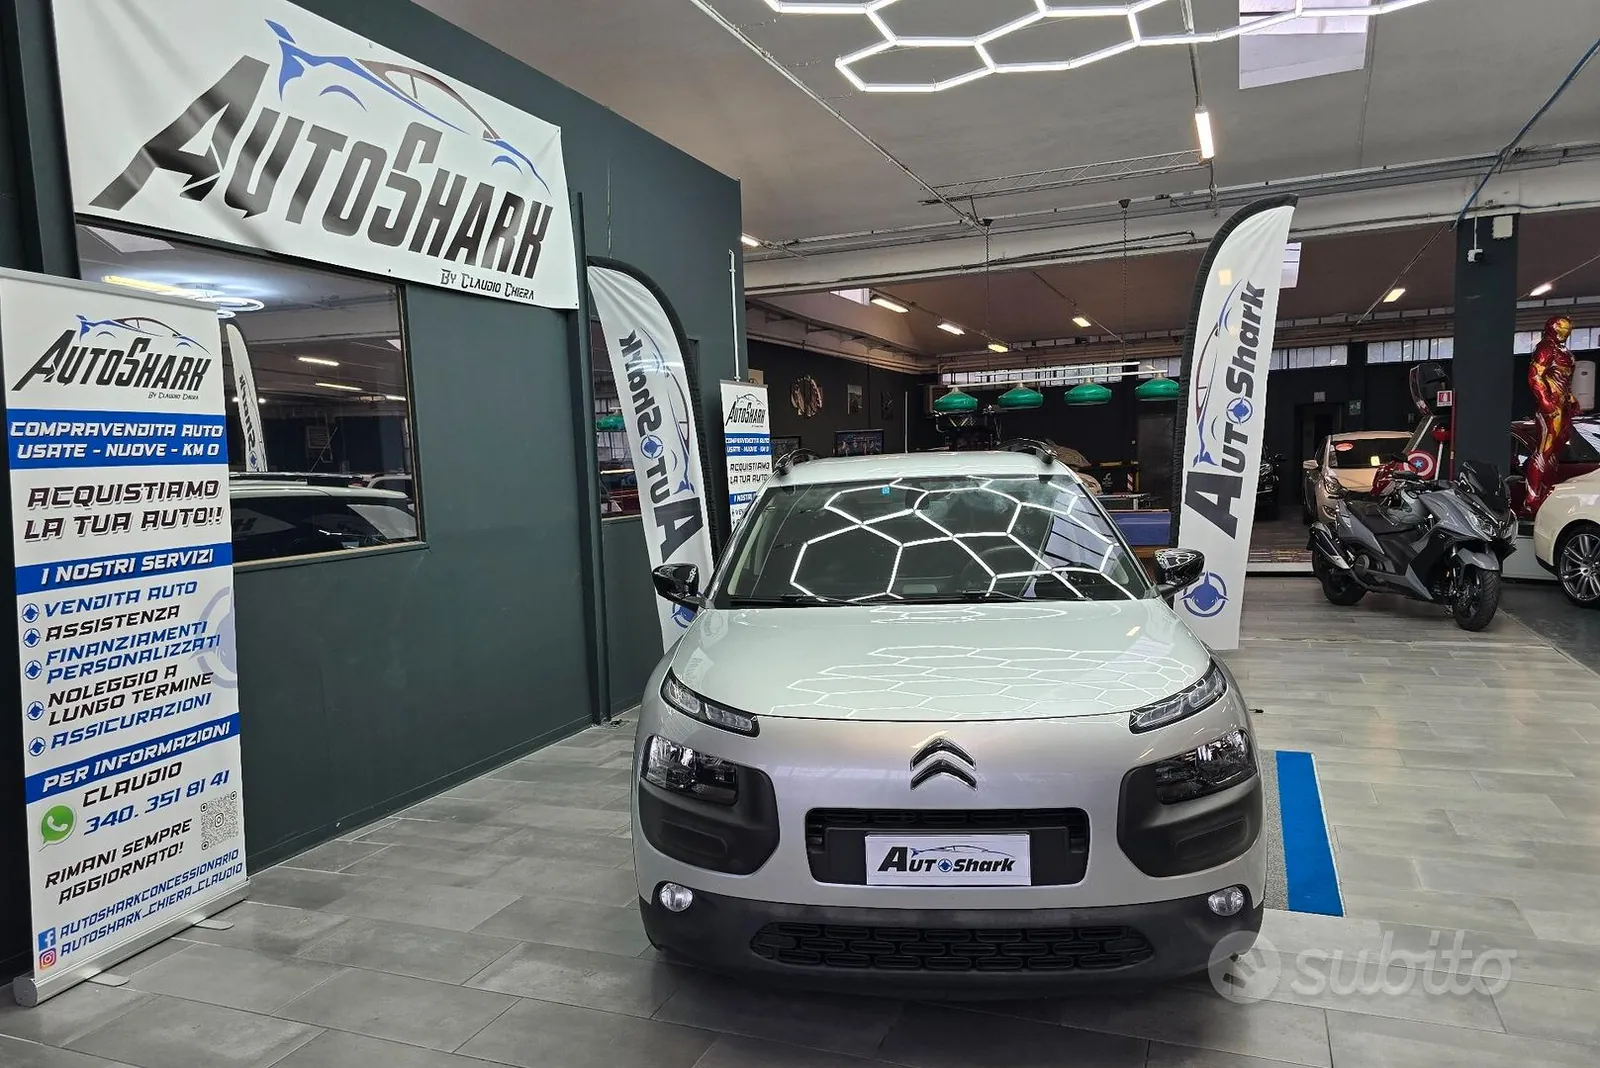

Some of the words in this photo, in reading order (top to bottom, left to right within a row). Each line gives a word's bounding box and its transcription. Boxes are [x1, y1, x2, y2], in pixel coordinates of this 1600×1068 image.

[10, 421, 176, 438] COMPRAVENDITA
[181, 424, 224, 438] AUTO
[17, 443, 88, 459] USATE
[105, 443, 166, 458] NUOVE
[182, 443, 204, 456] KM
[27, 479, 220, 509] ACQUISTIAMO
[24, 517, 65, 541] LA
[73, 511, 132, 537] TUA
[141, 506, 223, 530] AUTO!!
[41, 568, 49, 585] I
[55, 557, 136, 582] NOSTRI
[141, 548, 214, 572] SERVIZI
[44, 589, 141, 618] VENDITA
[147, 581, 198, 601] AUTO
[45, 605, 180, 642] ASSISTENZA
[46, 621, 208, 666] FINANZIAMENTI
[46, 634, 221, 684] PERSONALIZZATI
[47, 669, 158, 708] NOLEGGIO
[164, 664, 178, 680] A
[48, 694, 126, 726] LUNGO
[131, 671, 214, 704] TERMINE
[50, 692, 212, 750] ASSICURAZIONI
[42, 769, 87, 793] PER
[93, 721, 231, 775] INFORMAZIONI
[82, 761, 183, 808] CLAUDIO
[84, 804, 139, 835] 340.
[144, 787, 180, 814] 351
[185, 778, 206, 797] 81
[210, 769, 230, 787] 41
[45, 848, 117, 889] RIMANI
[121, 818, 193, 858] SEMPRE
[58, 841, 185, 906] AGGIORNATO!
[59, 848, 239, 939] AUTOSHARKCONCESSIONARIO
[60, 861, 243, 957] AUTOSHARK_CHIERA_CLAUDIO
